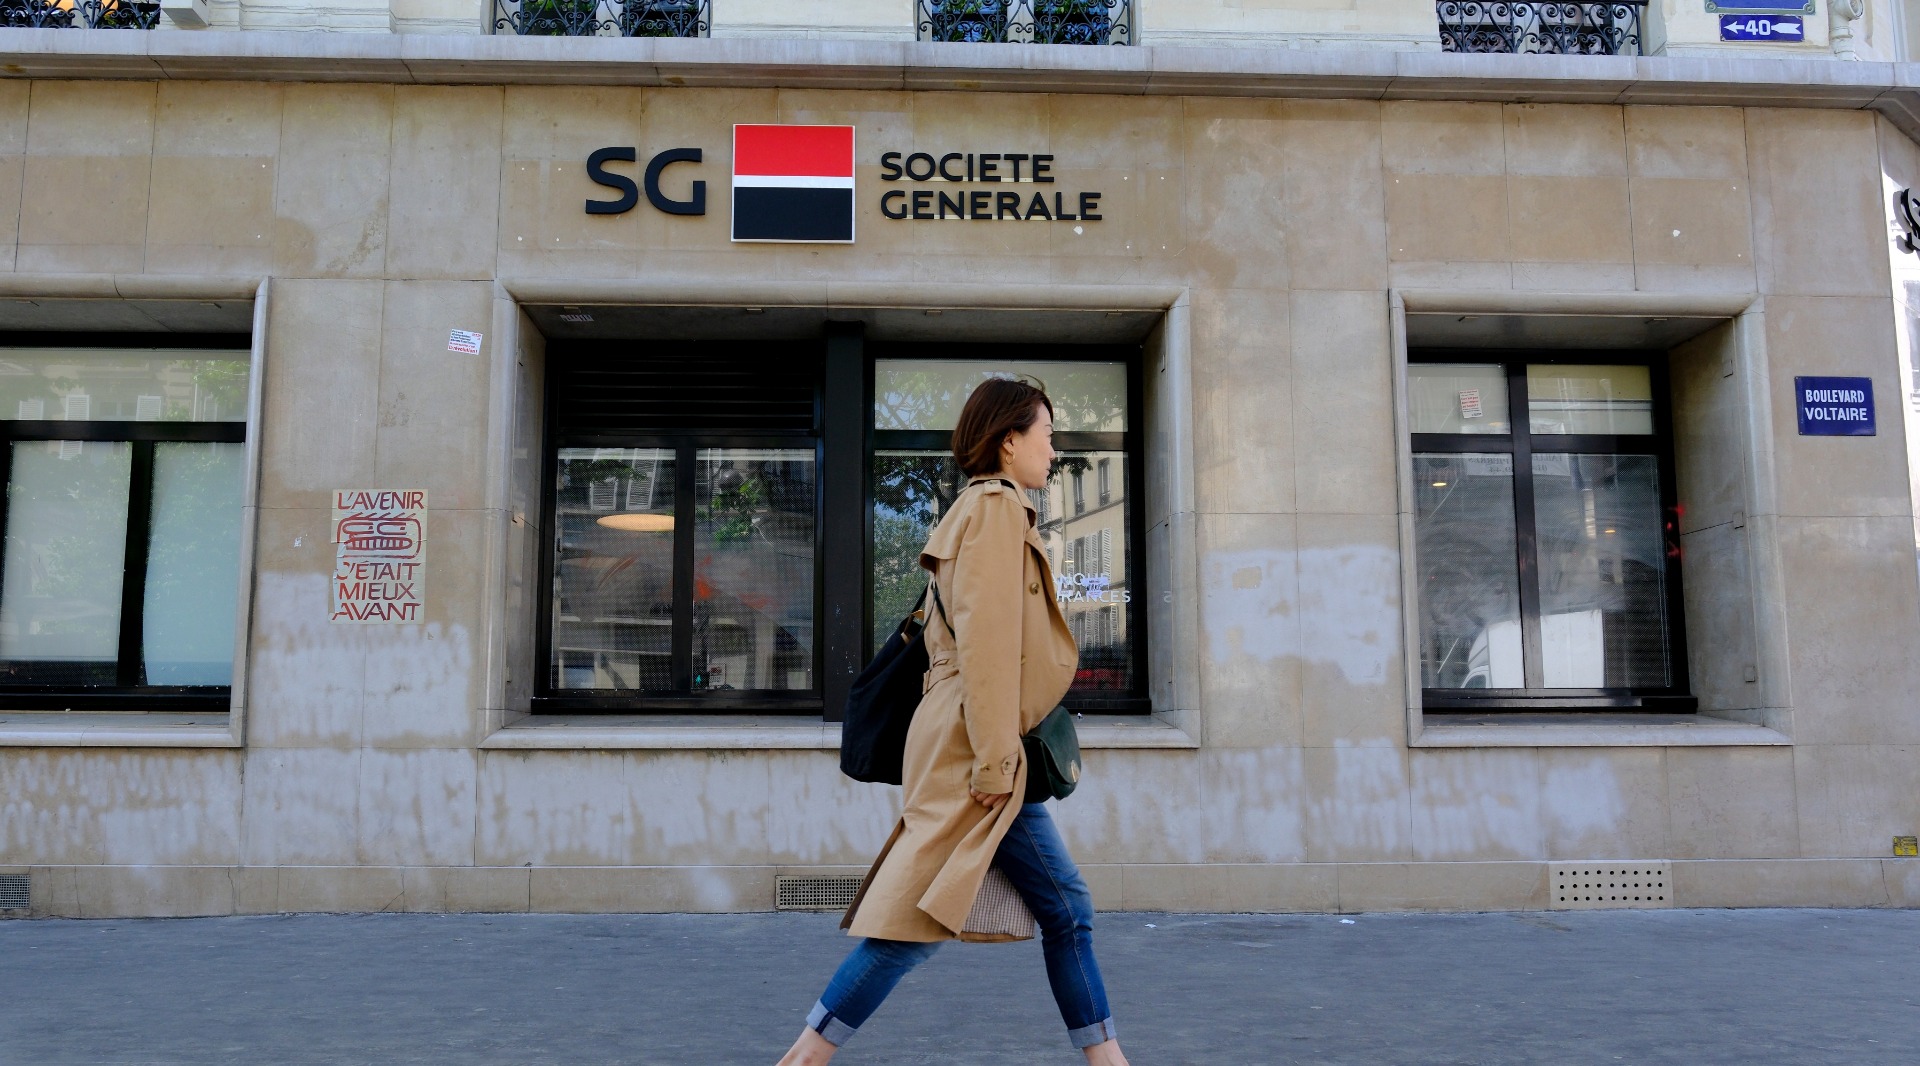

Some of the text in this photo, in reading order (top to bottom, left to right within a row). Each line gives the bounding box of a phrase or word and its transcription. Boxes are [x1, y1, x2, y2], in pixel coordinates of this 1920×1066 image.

[1745, 19, 1771, 36] 40
[880, 152, 1055, 182] SOCIETE
[585, 146, 706, 216] SG
[880, 190, 1103, 221] GENERALE
[1805, 389, 1865, 403] BOULEVARD
[1804, 407, 1868, 421] VOLTAIRE
[337, 491, 425, 511] L'AVENIR
[336, 560, 421, 581] C'ÉTAIT
[338, 582, 416, 601] MIEUX
[332, 602, 421, 621] AVANT
